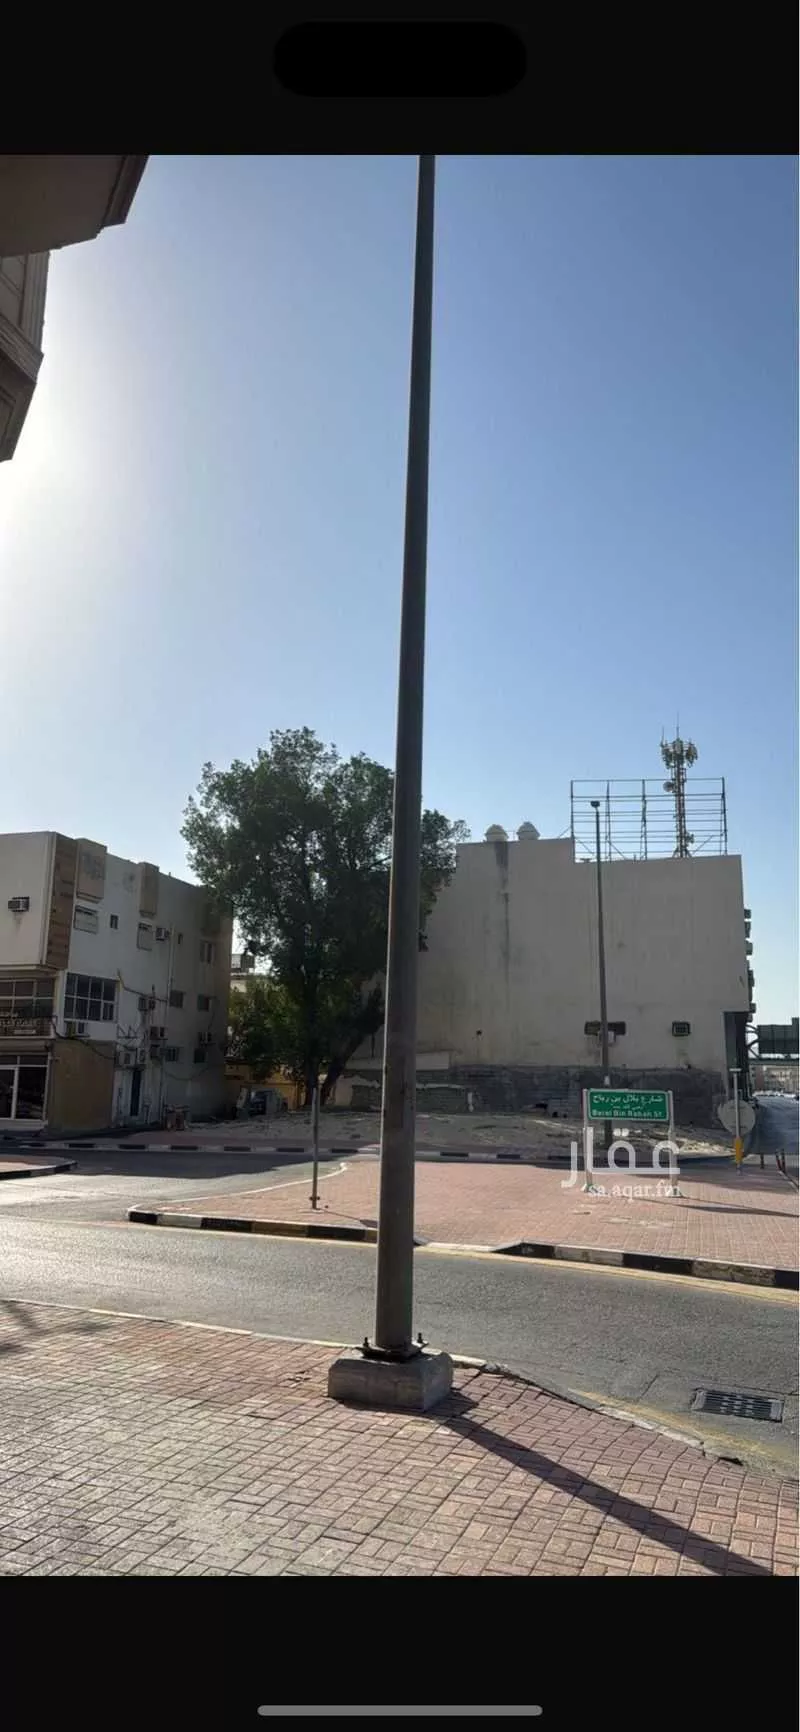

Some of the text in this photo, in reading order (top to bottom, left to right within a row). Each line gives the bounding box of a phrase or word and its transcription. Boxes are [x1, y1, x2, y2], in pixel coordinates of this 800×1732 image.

[592, 1094, 664, 1106] شارع بلال بن رباح
